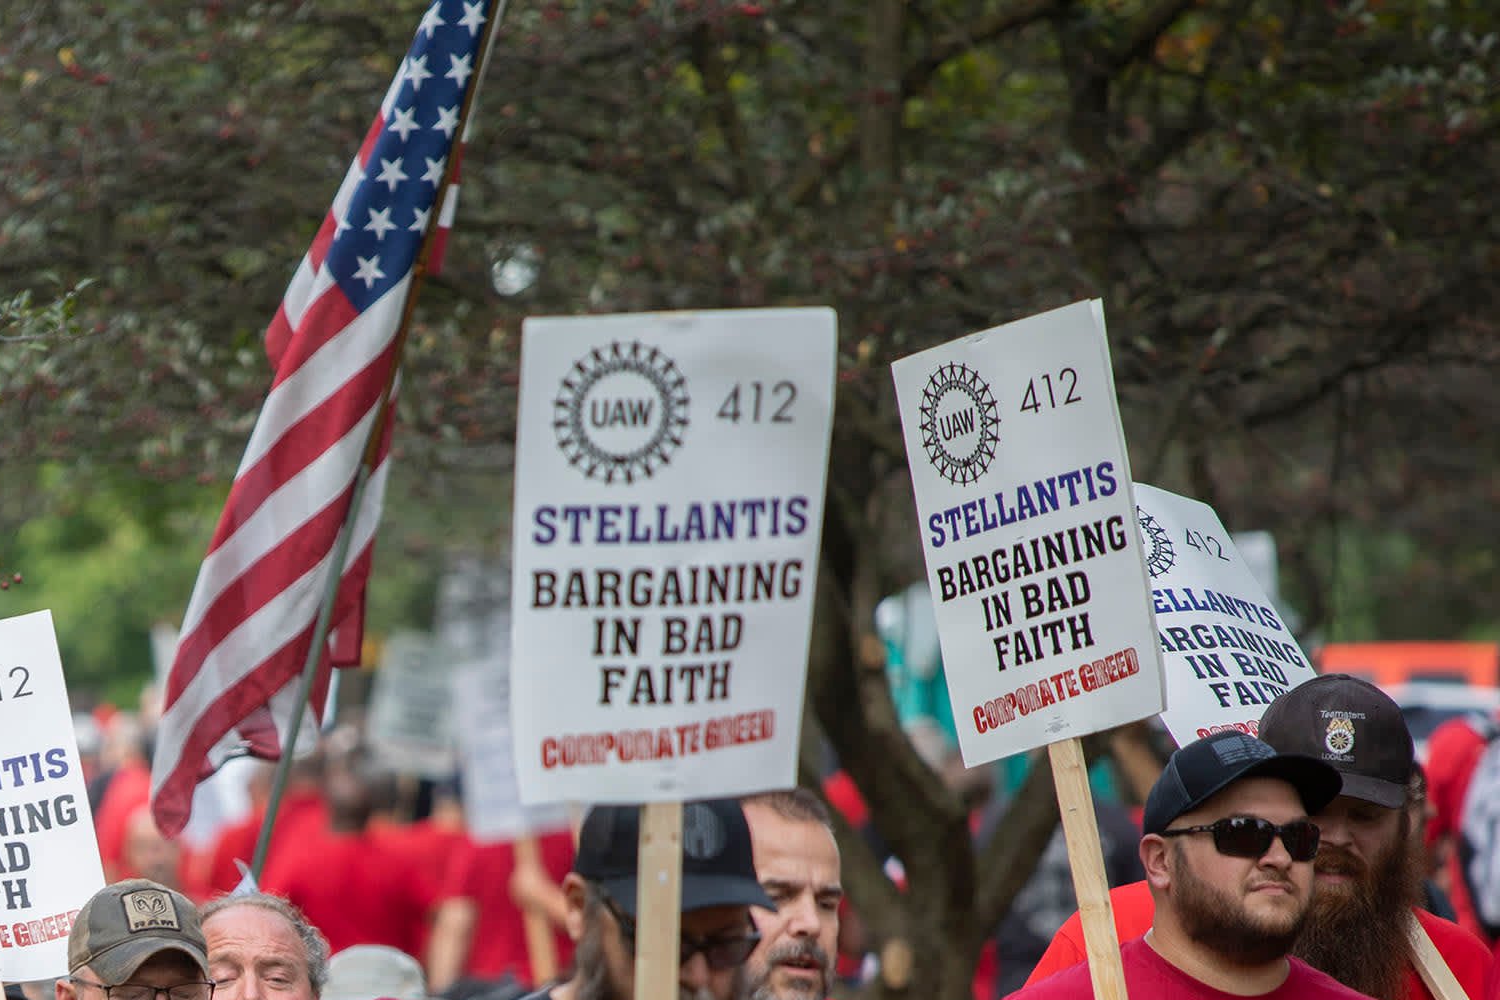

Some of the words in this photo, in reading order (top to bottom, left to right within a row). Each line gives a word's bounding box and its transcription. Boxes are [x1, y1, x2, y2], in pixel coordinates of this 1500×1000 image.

[717, 381, 798, 424] 412
[1020, 367, 1082, 414] 412
[591, 398, 654, 429] UAW
[940, 408, 976, 441] UAW
[533, 497, 809, 545] STELLANTIS
[929, 461, 1118, 548] STELLANTIS
[937, 515, 1128, 603] BARGAINING
[1186, 528, 1230, 561] 412
[531, 561, 803, 610] BARGAINING
[981, 591, 1013, 633] IN
[1020, 570, 1092, 620] BAD
[1152, 588, 1283, 631] ELLANTIS
[593, 617, 642, 656] IN
[662, 614, 744, 655] BAD
[994, 612, 1096, 672] FAITH
[1159, 624, 1306, 668] ARGAINING
[599, 662, 732, 705] FAITH
[973, 671, 1080, 735] CORPORATE
[1079, 647, 1141, 694] GREED
[1185, 653, 1229, 679] IN
[1231, 653, 1290, 687] BAD
[541, 722, 700, 769] CORPORATE
[705, 709, 776, 750] GREED
[134, 919, 175, 929] RAM
